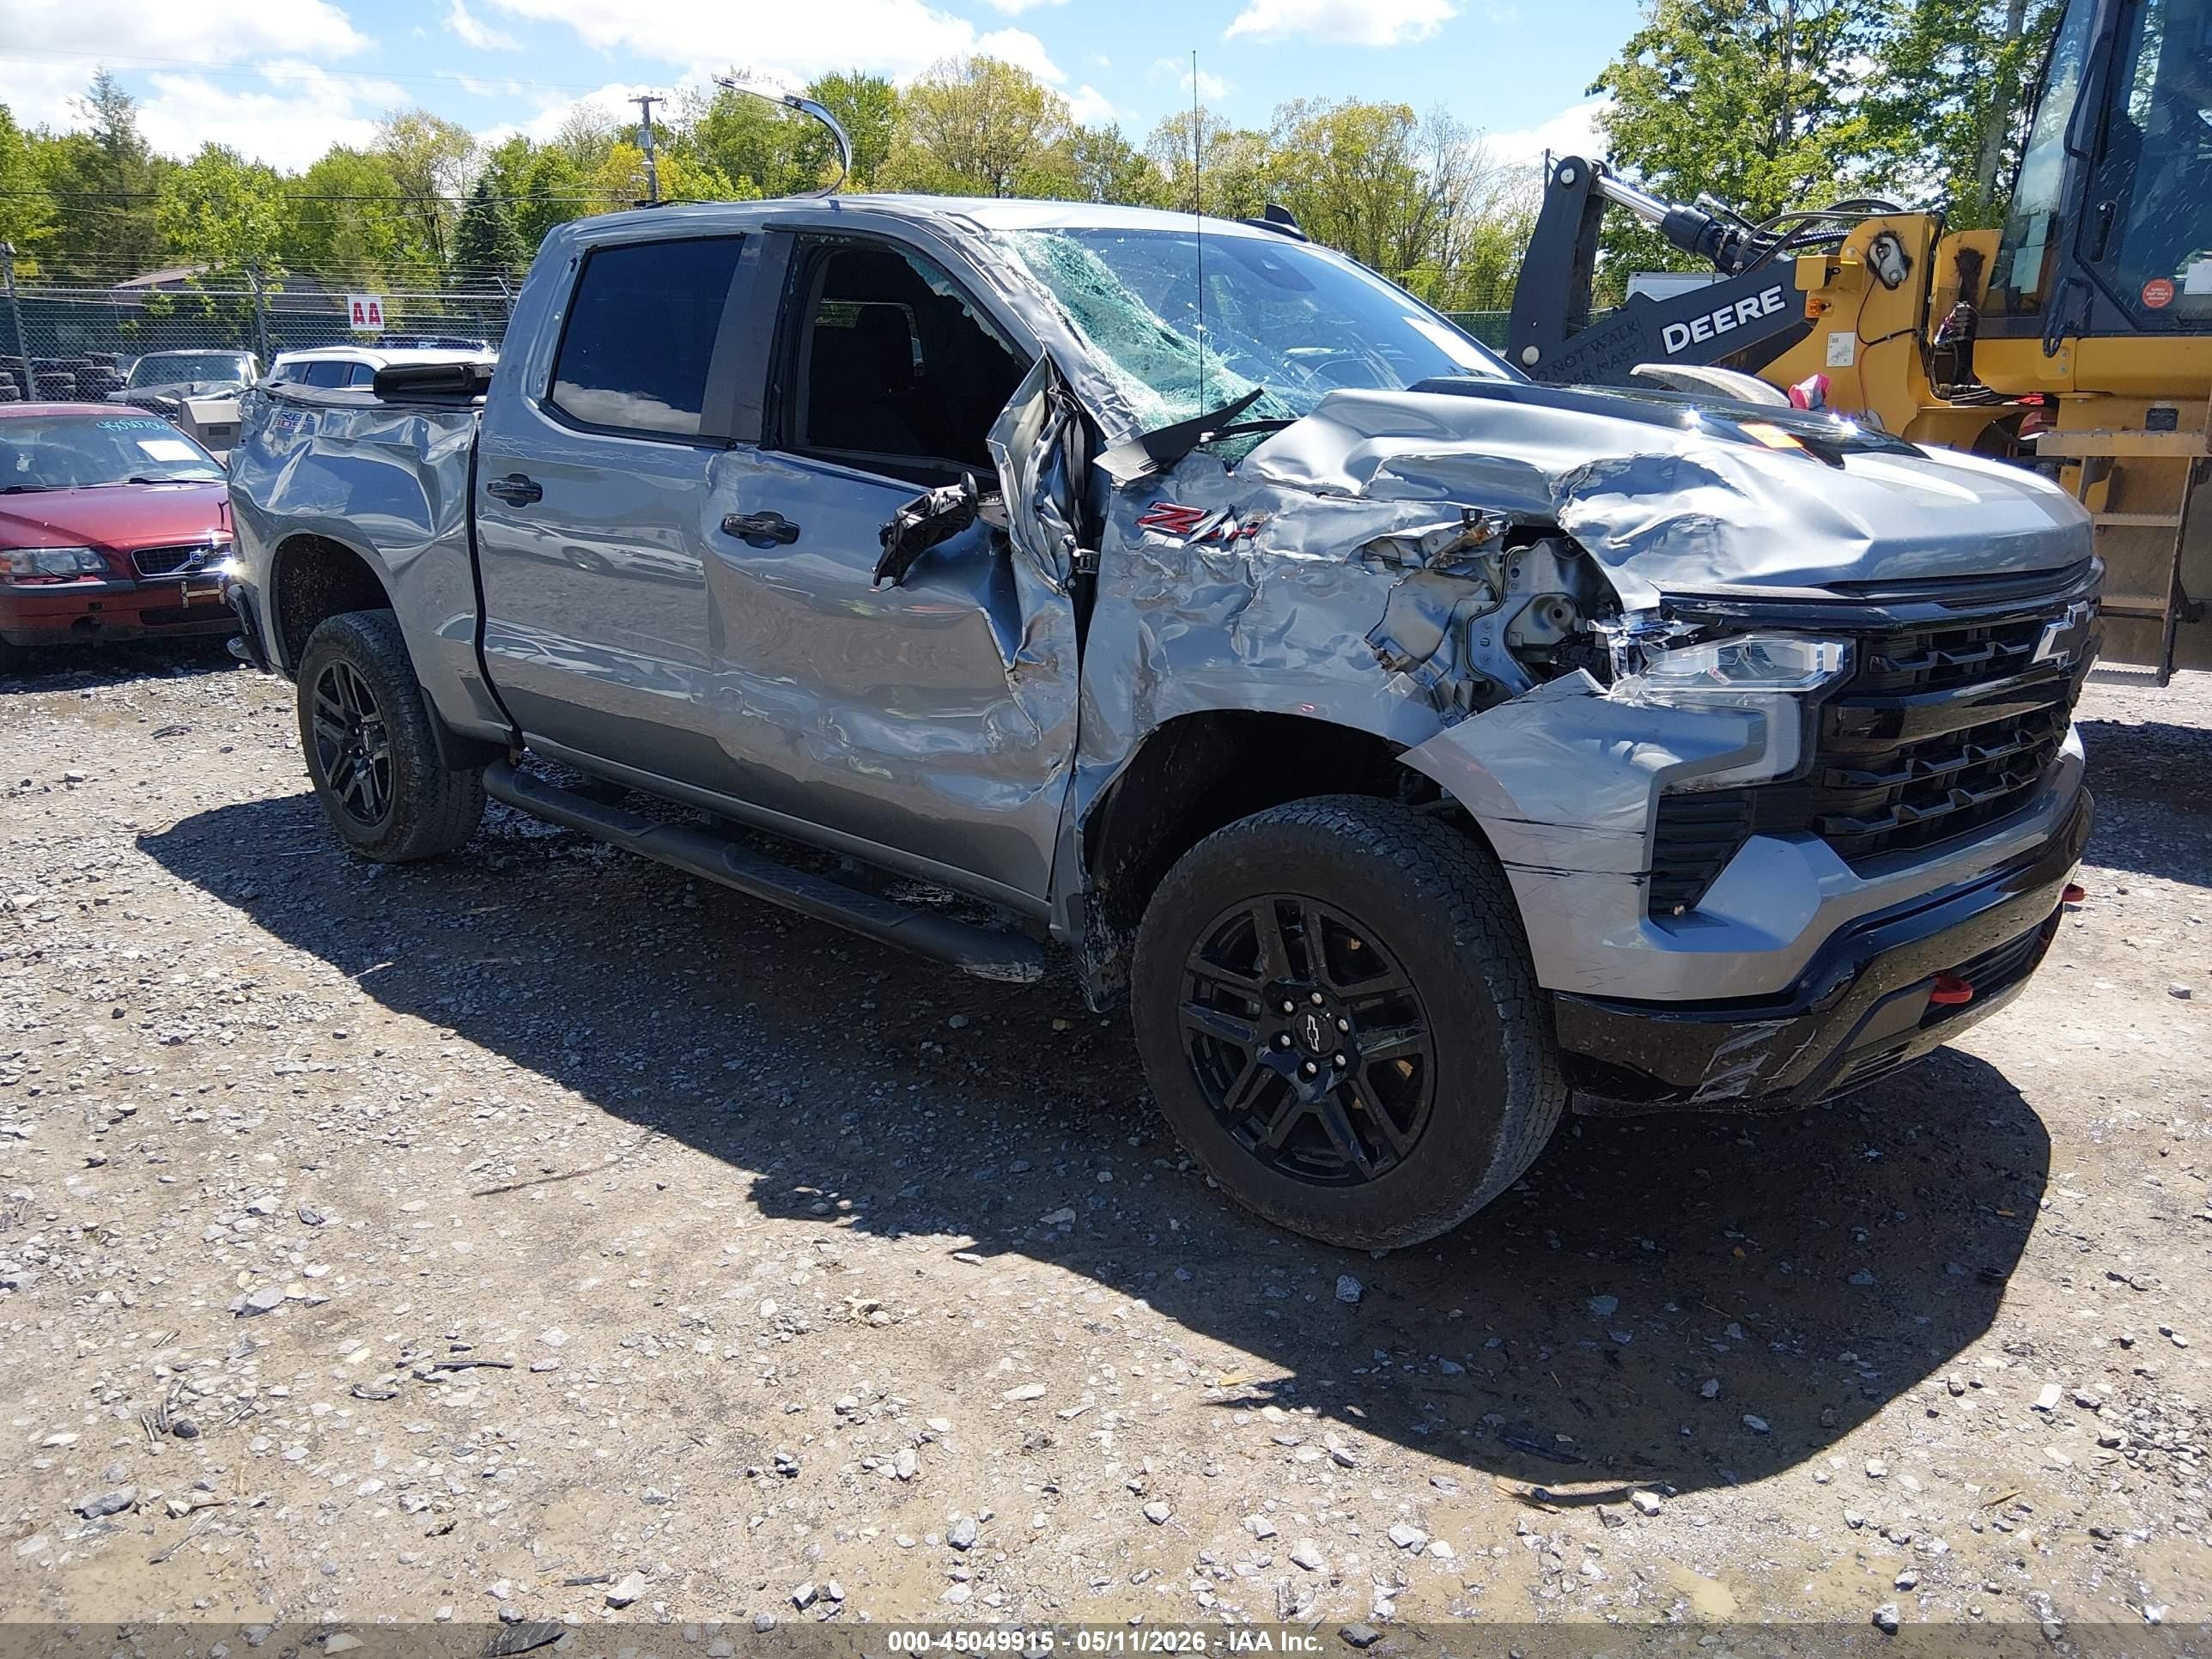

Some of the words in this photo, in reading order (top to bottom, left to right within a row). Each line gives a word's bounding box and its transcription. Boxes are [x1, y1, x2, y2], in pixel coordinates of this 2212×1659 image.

[353, 301, 382, 325] AA
[1662, 285, 1786, 355] DEERE
[1553, 349, 1585, 375] NOT
